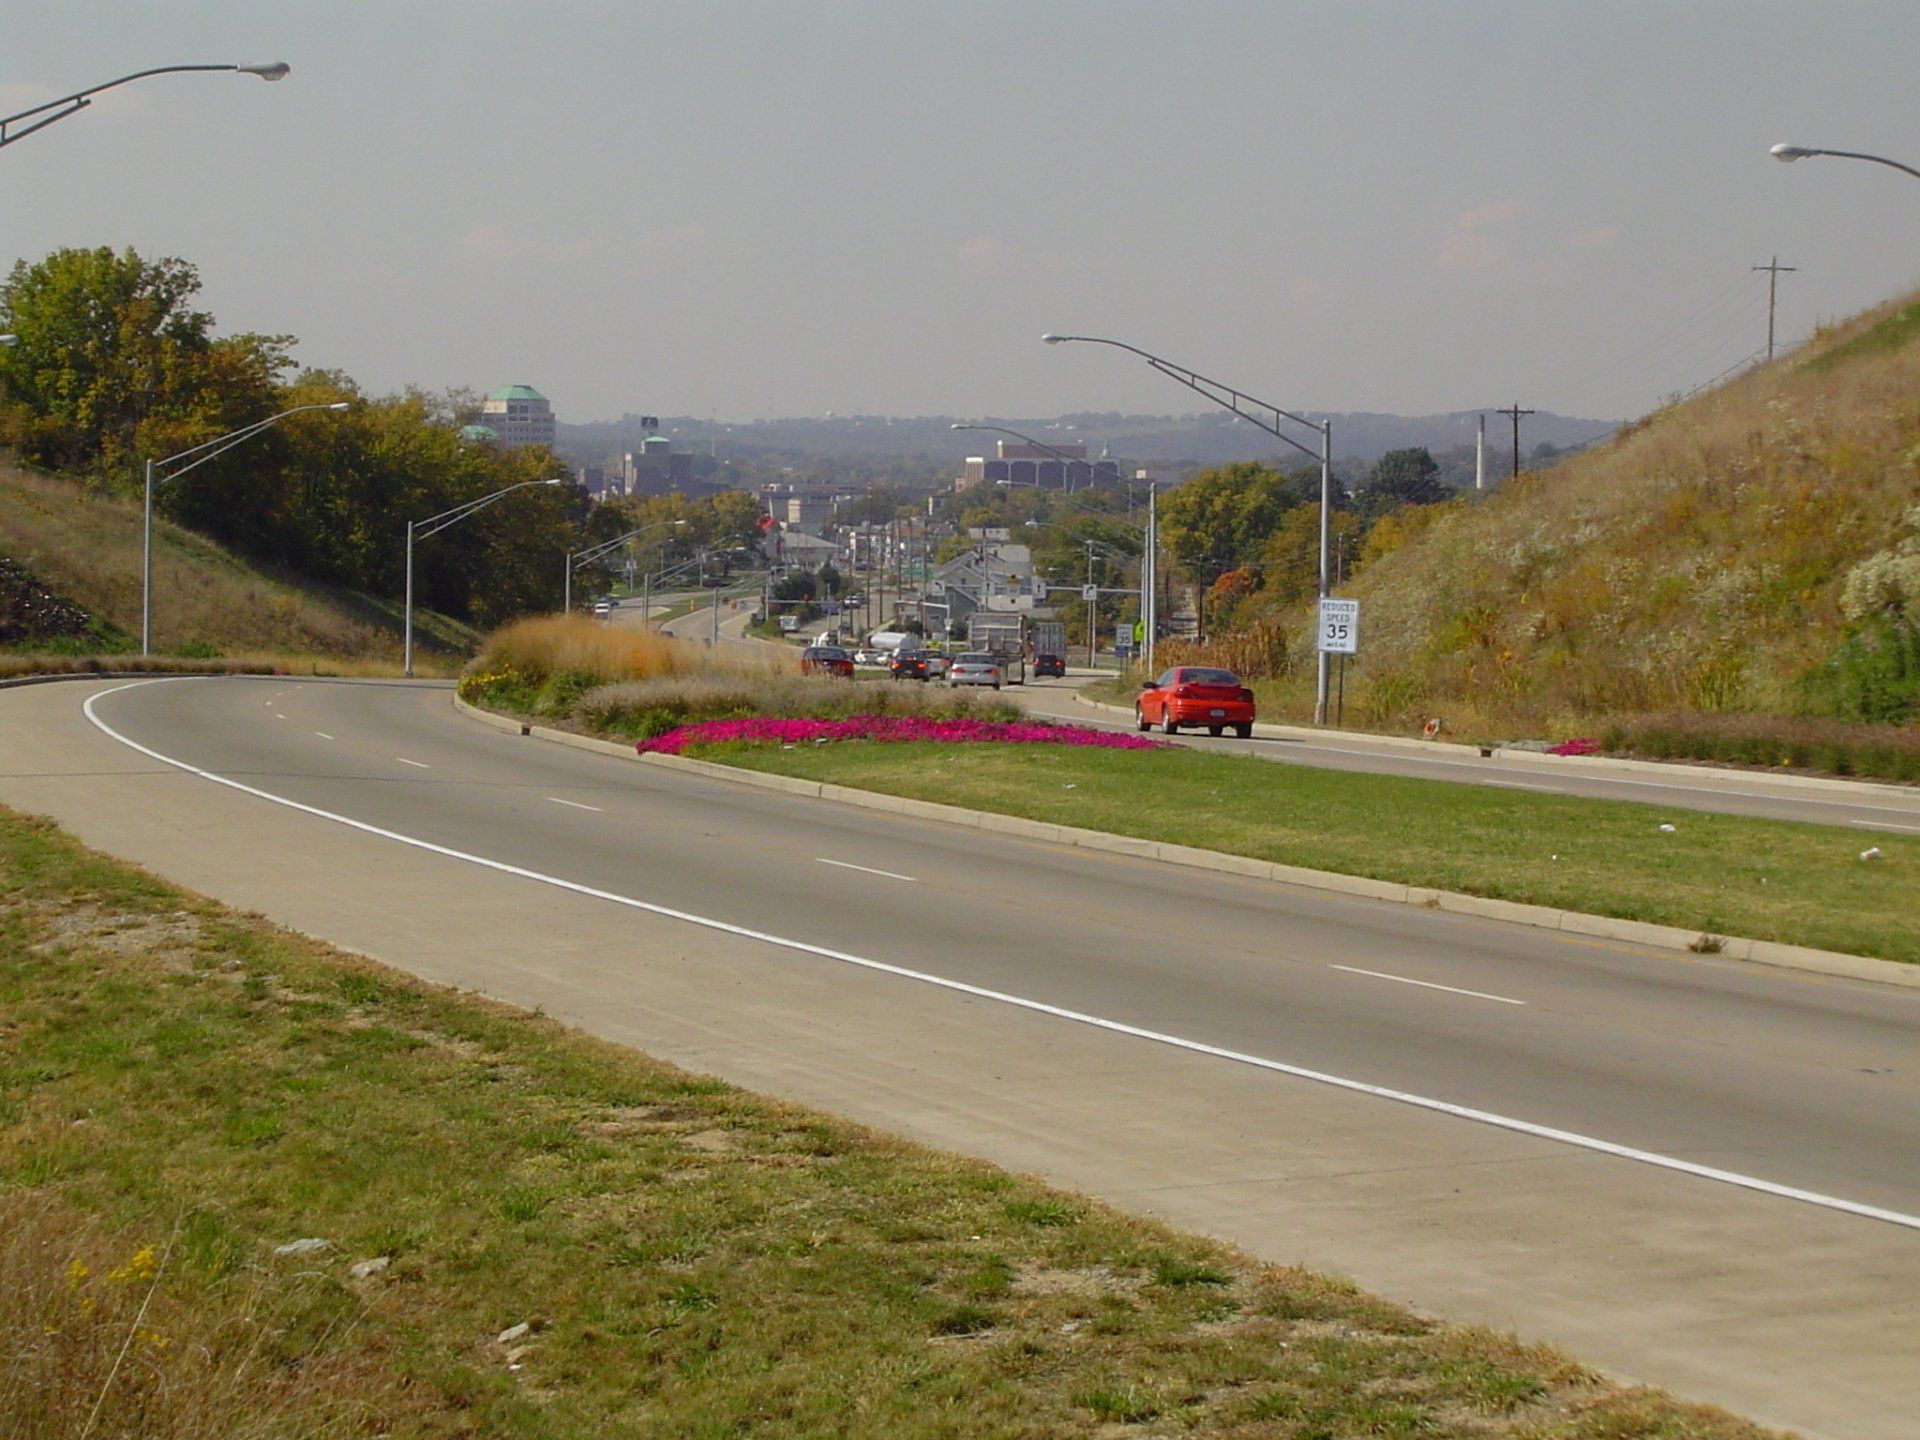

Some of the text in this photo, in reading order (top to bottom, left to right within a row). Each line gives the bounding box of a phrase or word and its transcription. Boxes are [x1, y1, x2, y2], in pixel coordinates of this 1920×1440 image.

[1321, 602, 1356, 612] REDUCED
[1327, 613, 1350, 622] SPEED
[1326, 624, 1348, 639] 35
